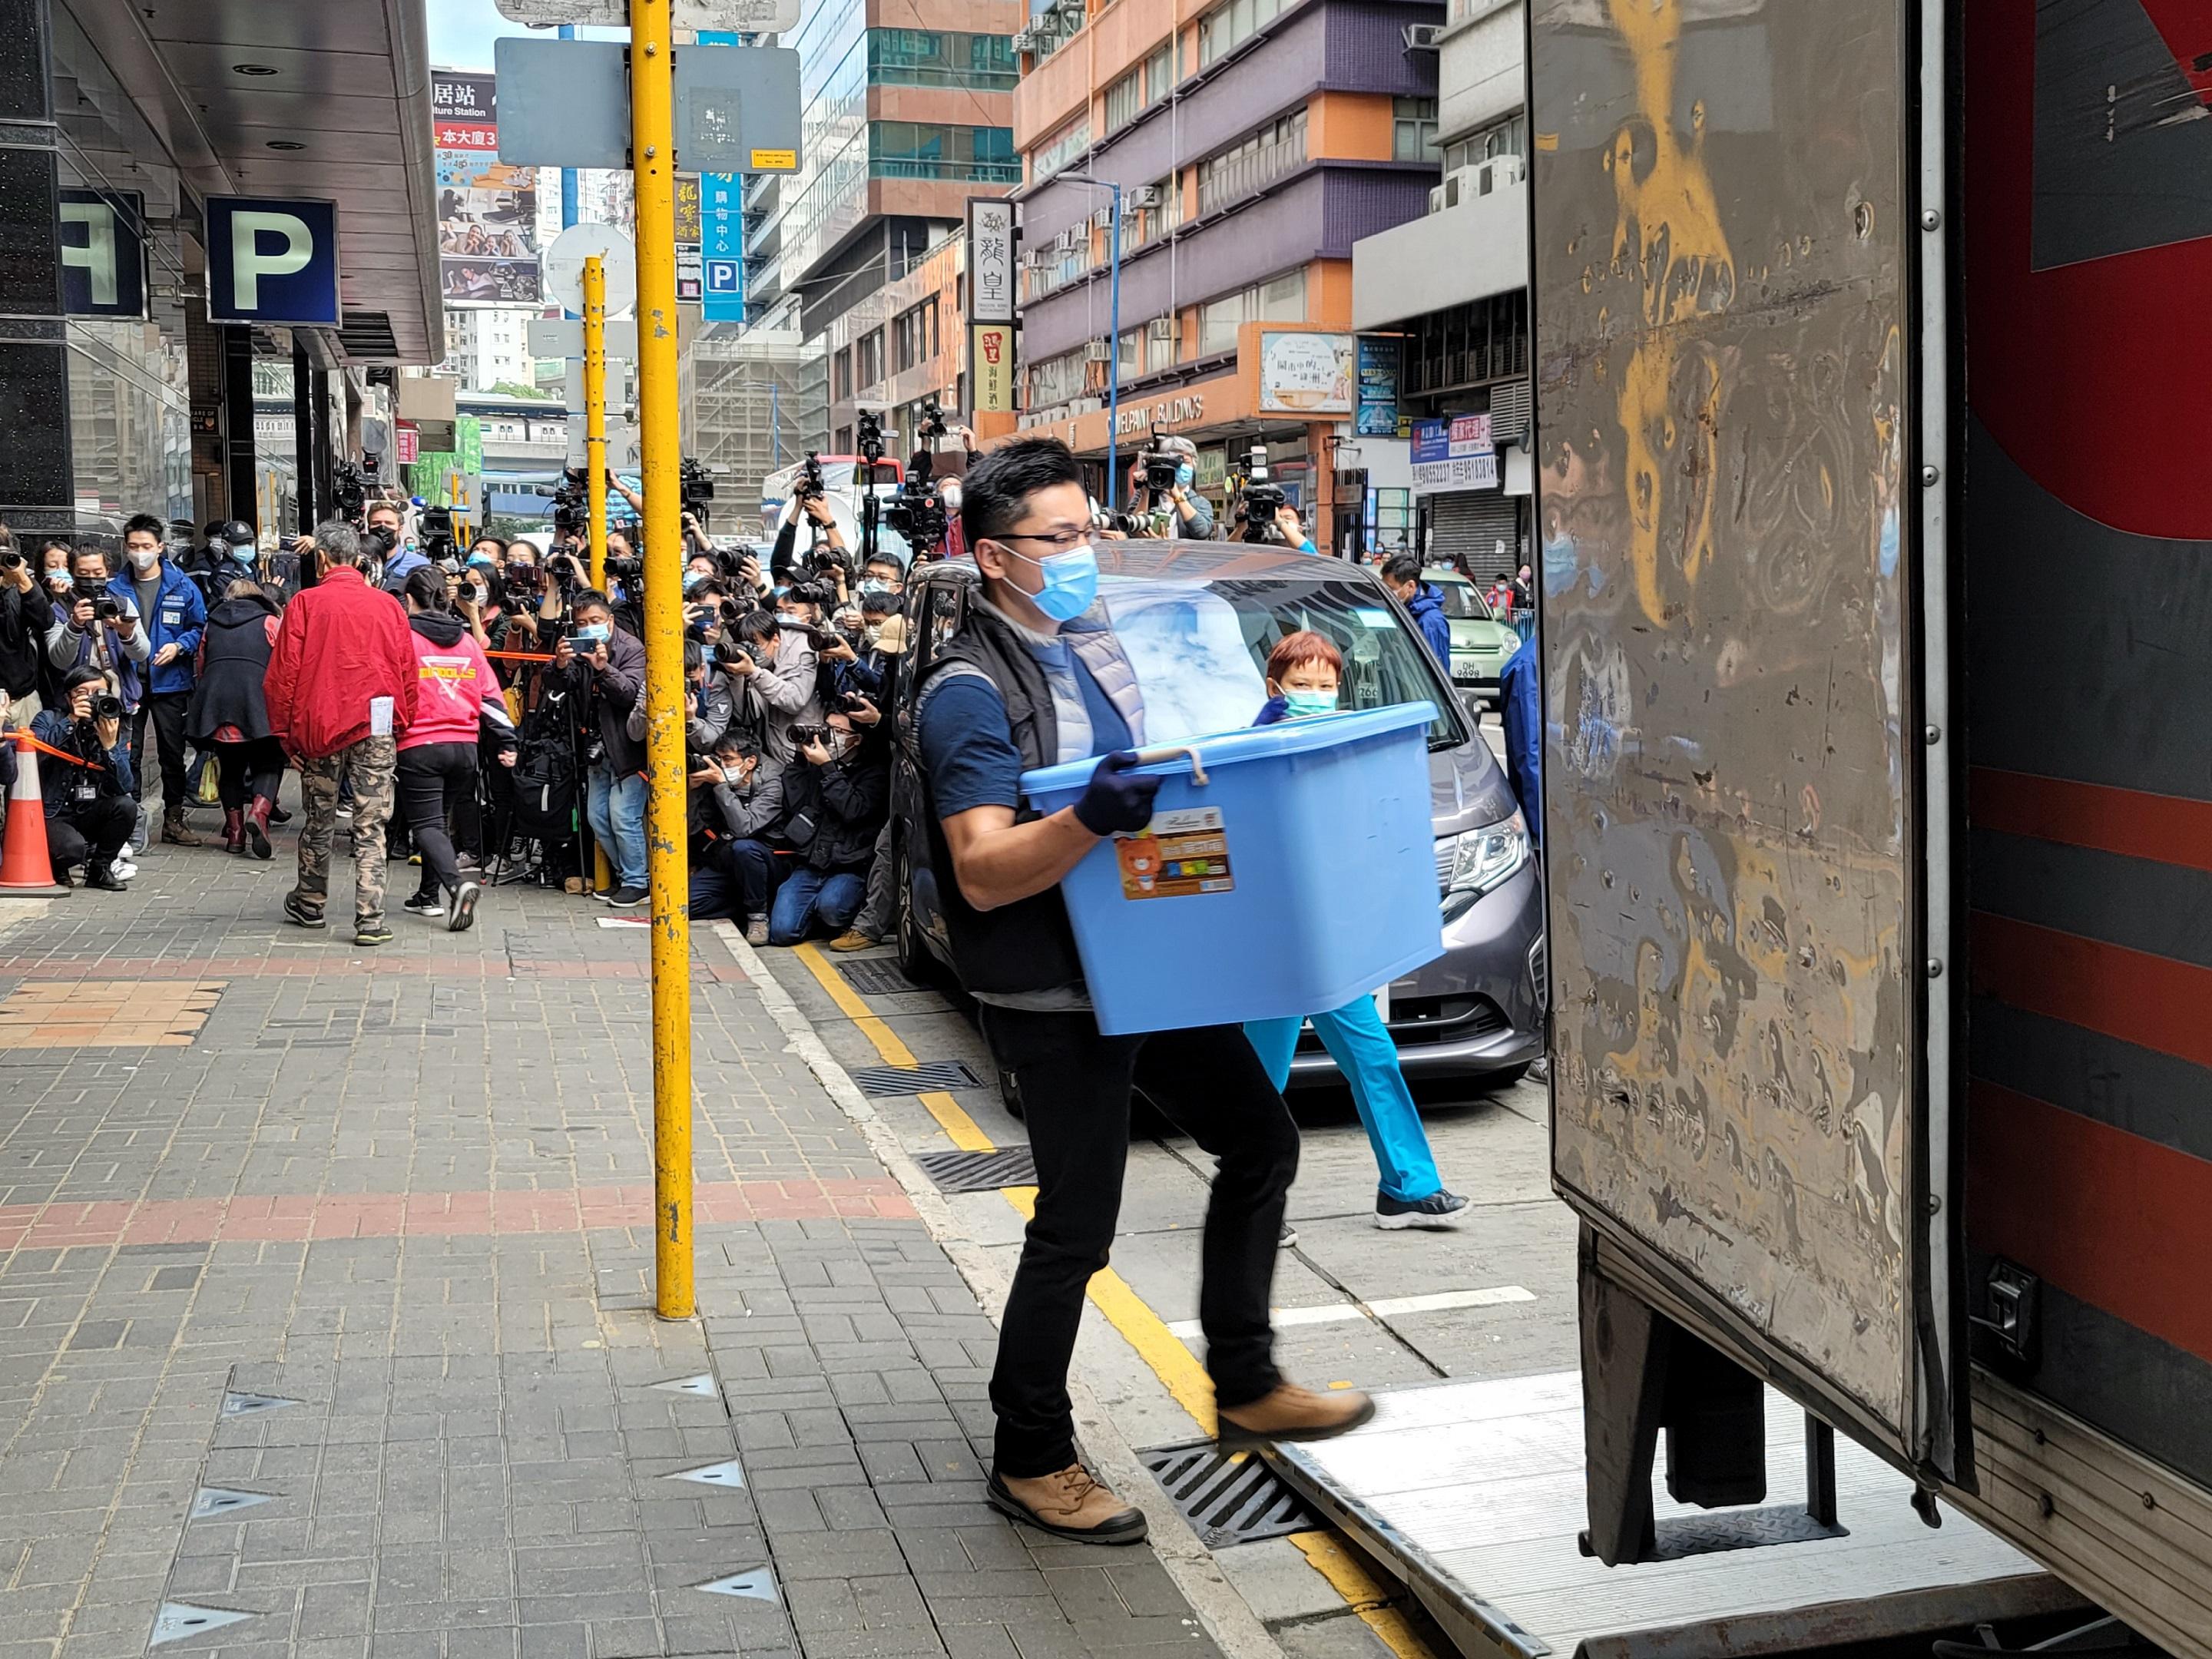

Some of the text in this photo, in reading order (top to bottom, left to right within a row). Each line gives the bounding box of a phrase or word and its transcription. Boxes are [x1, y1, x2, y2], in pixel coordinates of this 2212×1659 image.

[454, 108, 486, 117] Station
[715, 190, 729, 251] 購物中心
[231, 210, 313, 310] P
[714, 265, 732, 288] P
